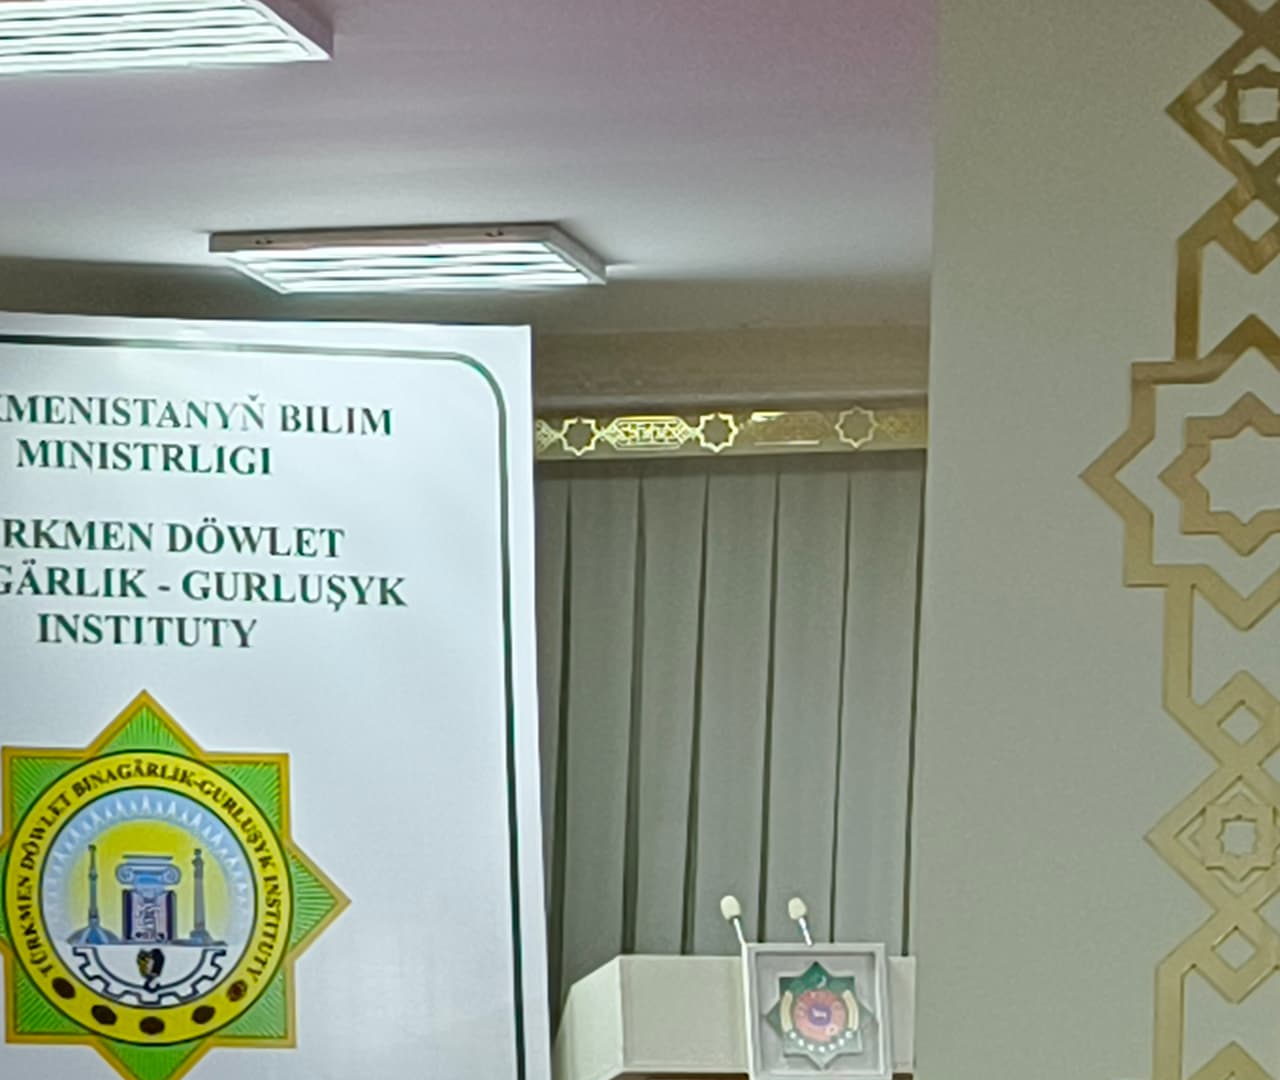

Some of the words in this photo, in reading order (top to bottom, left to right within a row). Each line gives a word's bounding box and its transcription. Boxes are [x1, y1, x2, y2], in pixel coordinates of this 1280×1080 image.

[279, 404, 393, 436] BILIM
[16, 439, 272, 475] MINISTRLIGI
[166, 517, 346, 558] DÖWLET
[182, 571, 407, 613] GURLUŞYK
[37, 613, 258, 649] INSTITUTY
[20, 791, 72, 871] DÖWLET
[17, 875, 54, 978] TÜRKMEN
[246, 874, 282, 984] INSTITUTY
